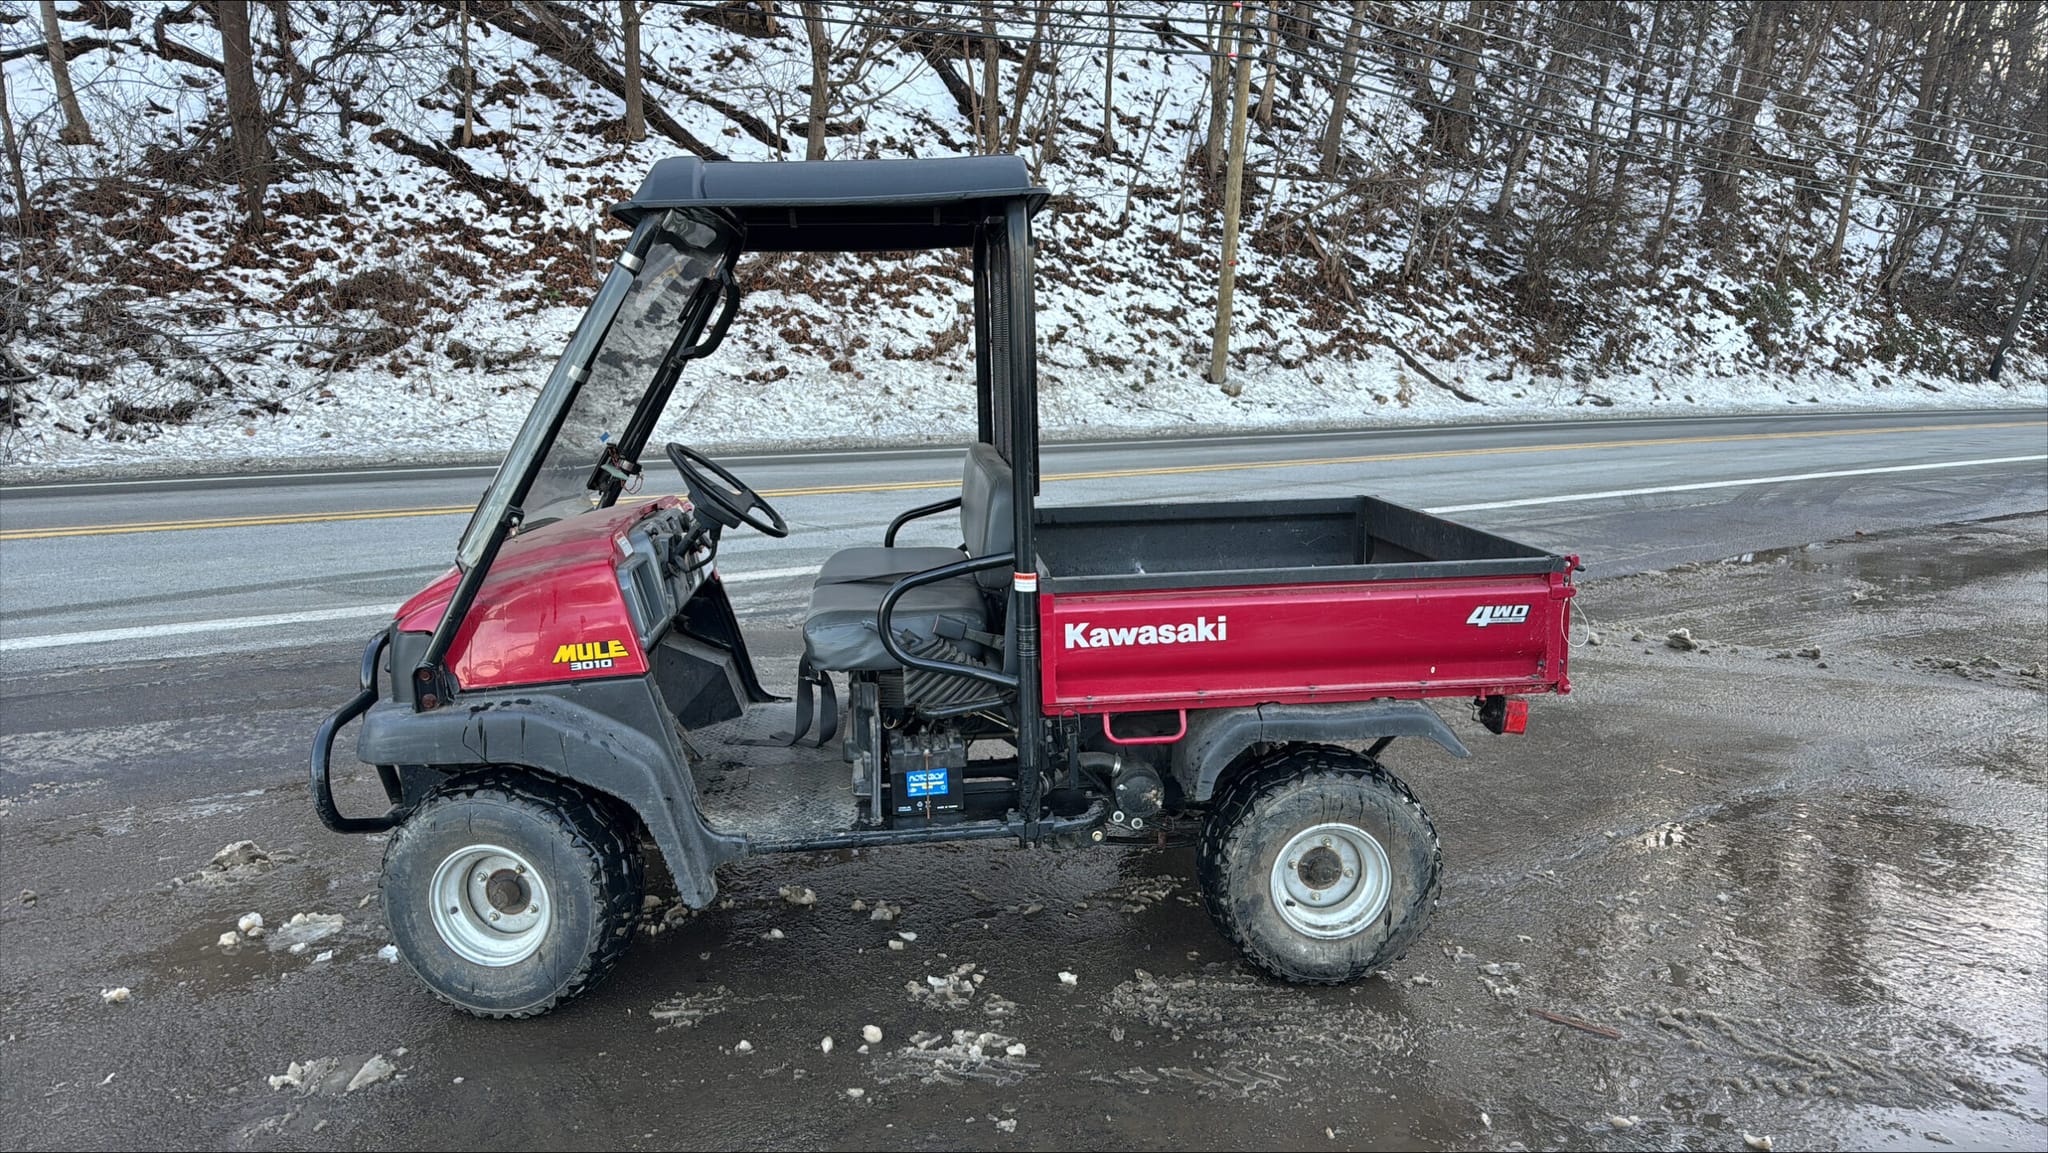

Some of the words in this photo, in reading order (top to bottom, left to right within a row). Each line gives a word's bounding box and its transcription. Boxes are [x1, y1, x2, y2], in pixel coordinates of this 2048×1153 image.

[1465, 605, 1530, 627] 4WD
[1064, 615, 1227, 649] Kawasaki
[552, 640, 629, 664] MULE
[570, 659, 613, 671] 3010
